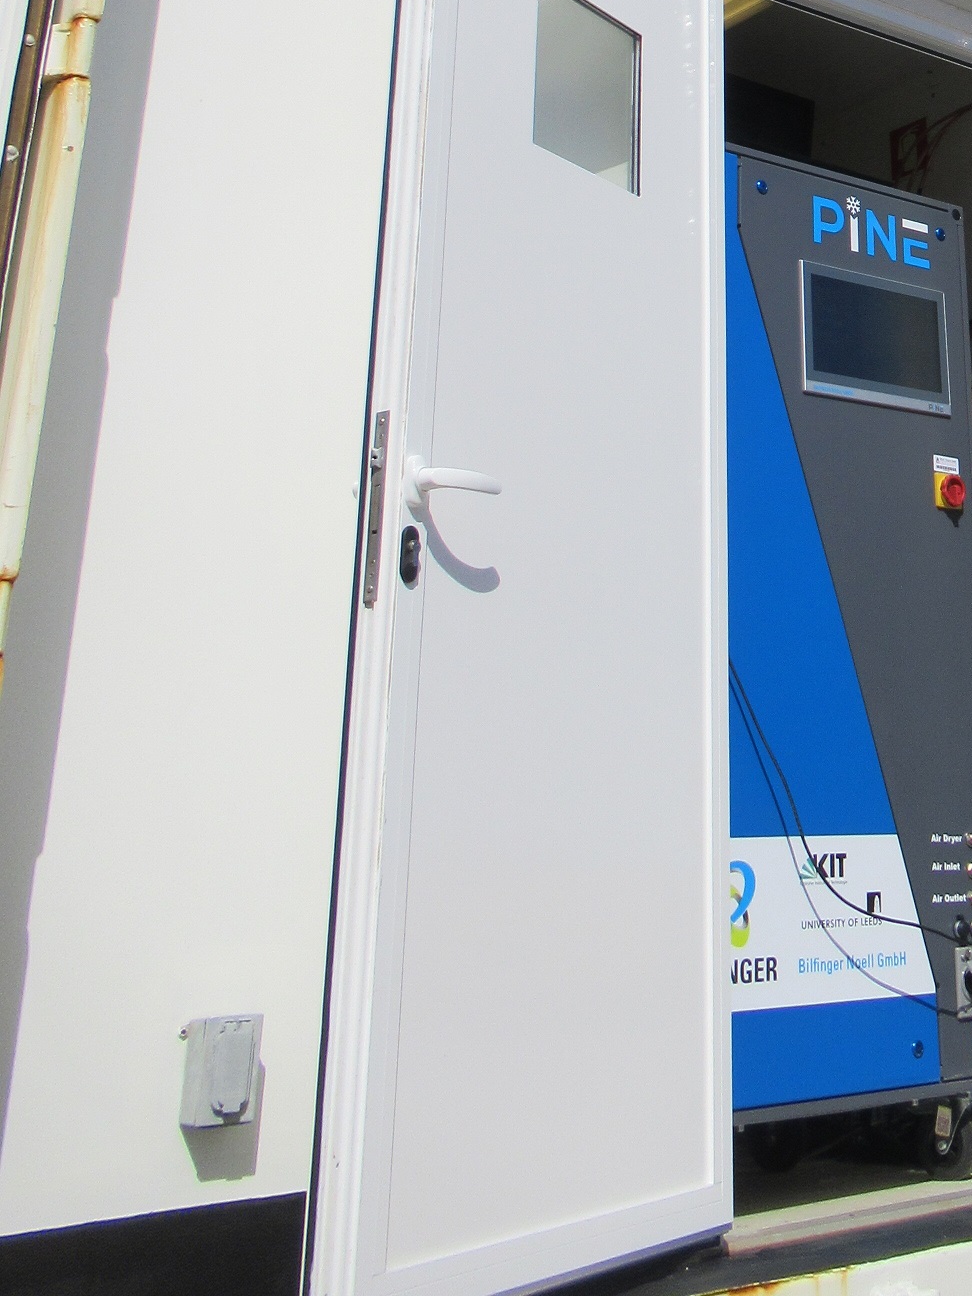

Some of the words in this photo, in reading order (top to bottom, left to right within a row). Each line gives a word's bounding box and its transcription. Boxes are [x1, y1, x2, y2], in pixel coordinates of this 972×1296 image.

[931, 833, 941, 842] Air
[943, 834, 963, 844] Dryer
[813, 853, 847, 878] KIT
[932, 862, 942, 871] Air
[944, 862, 961, 871] Inlet
[932, 894, 943, 903] Air
[944, 893, 967, 903] Outlet
[801, 918, 845, 930] UNIVERSITY
[848, 917, 859, 927] OF
[861, 916, 883, 926] LEEDS
[798, 957, 844, 975] Bilfinger
[847, 954, 874, 969] Noell
[878, 951, 907, 967] GmbH
